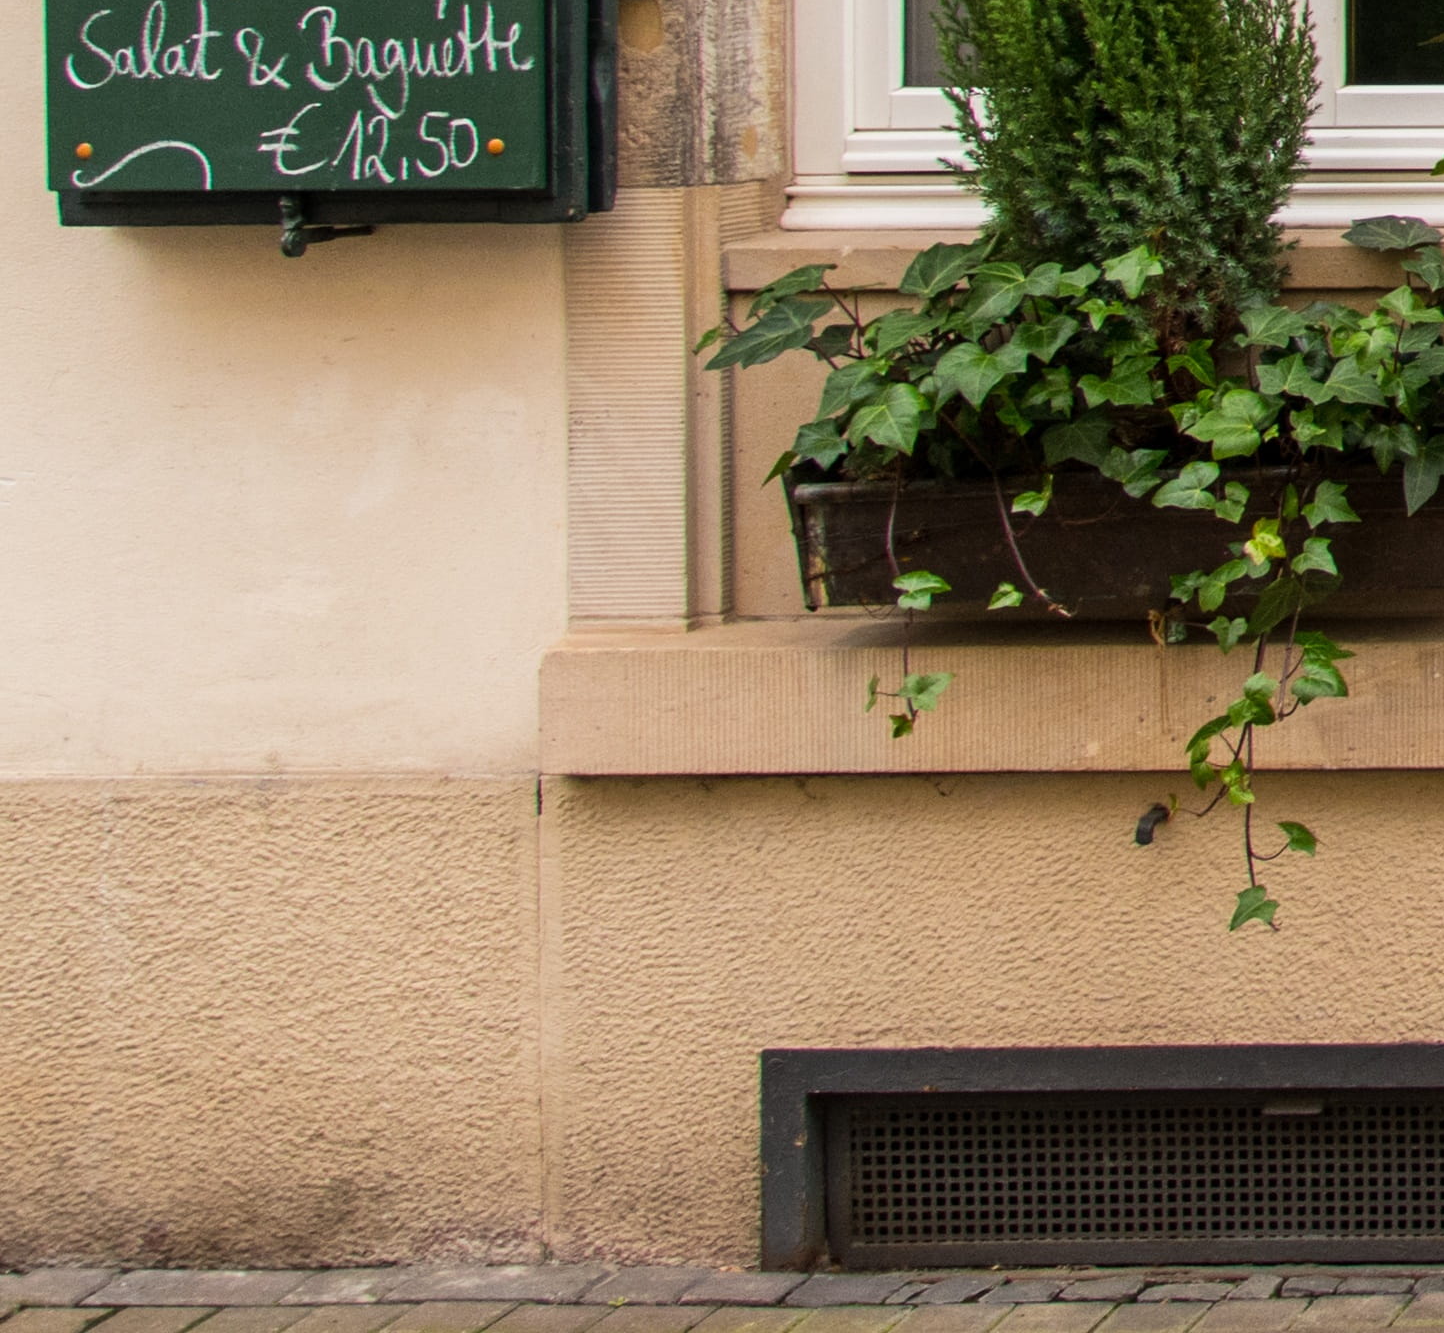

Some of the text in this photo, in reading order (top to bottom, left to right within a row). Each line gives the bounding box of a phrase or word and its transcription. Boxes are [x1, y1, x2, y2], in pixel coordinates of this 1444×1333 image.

[66, 0, 533, 118] Salat & Baguette
